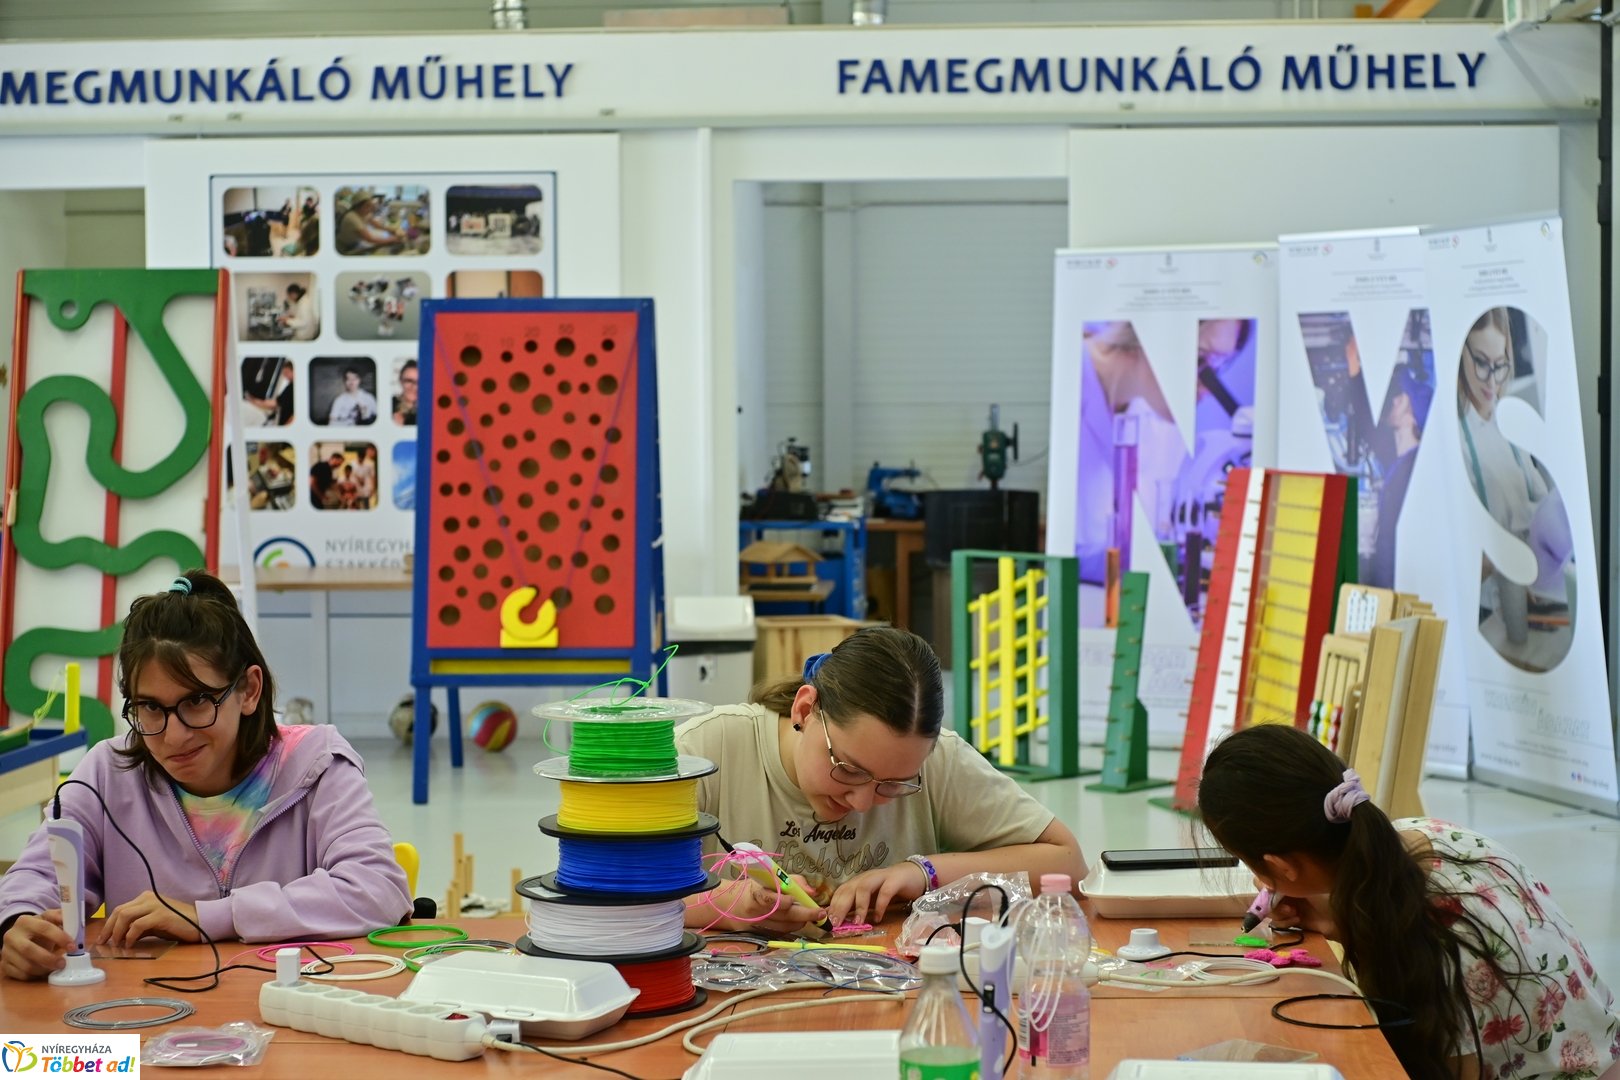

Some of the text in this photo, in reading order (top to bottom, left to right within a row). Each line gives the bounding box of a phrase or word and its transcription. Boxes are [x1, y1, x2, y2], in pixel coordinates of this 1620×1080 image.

[1, 55, 574, 105] MEGMUNKÁLÓ MŰHELY
[836, 45, 1487, 95] FAMEGMUNKÁLÓ MŰHELY
[780, 821, 857, 843] Los Angeles
